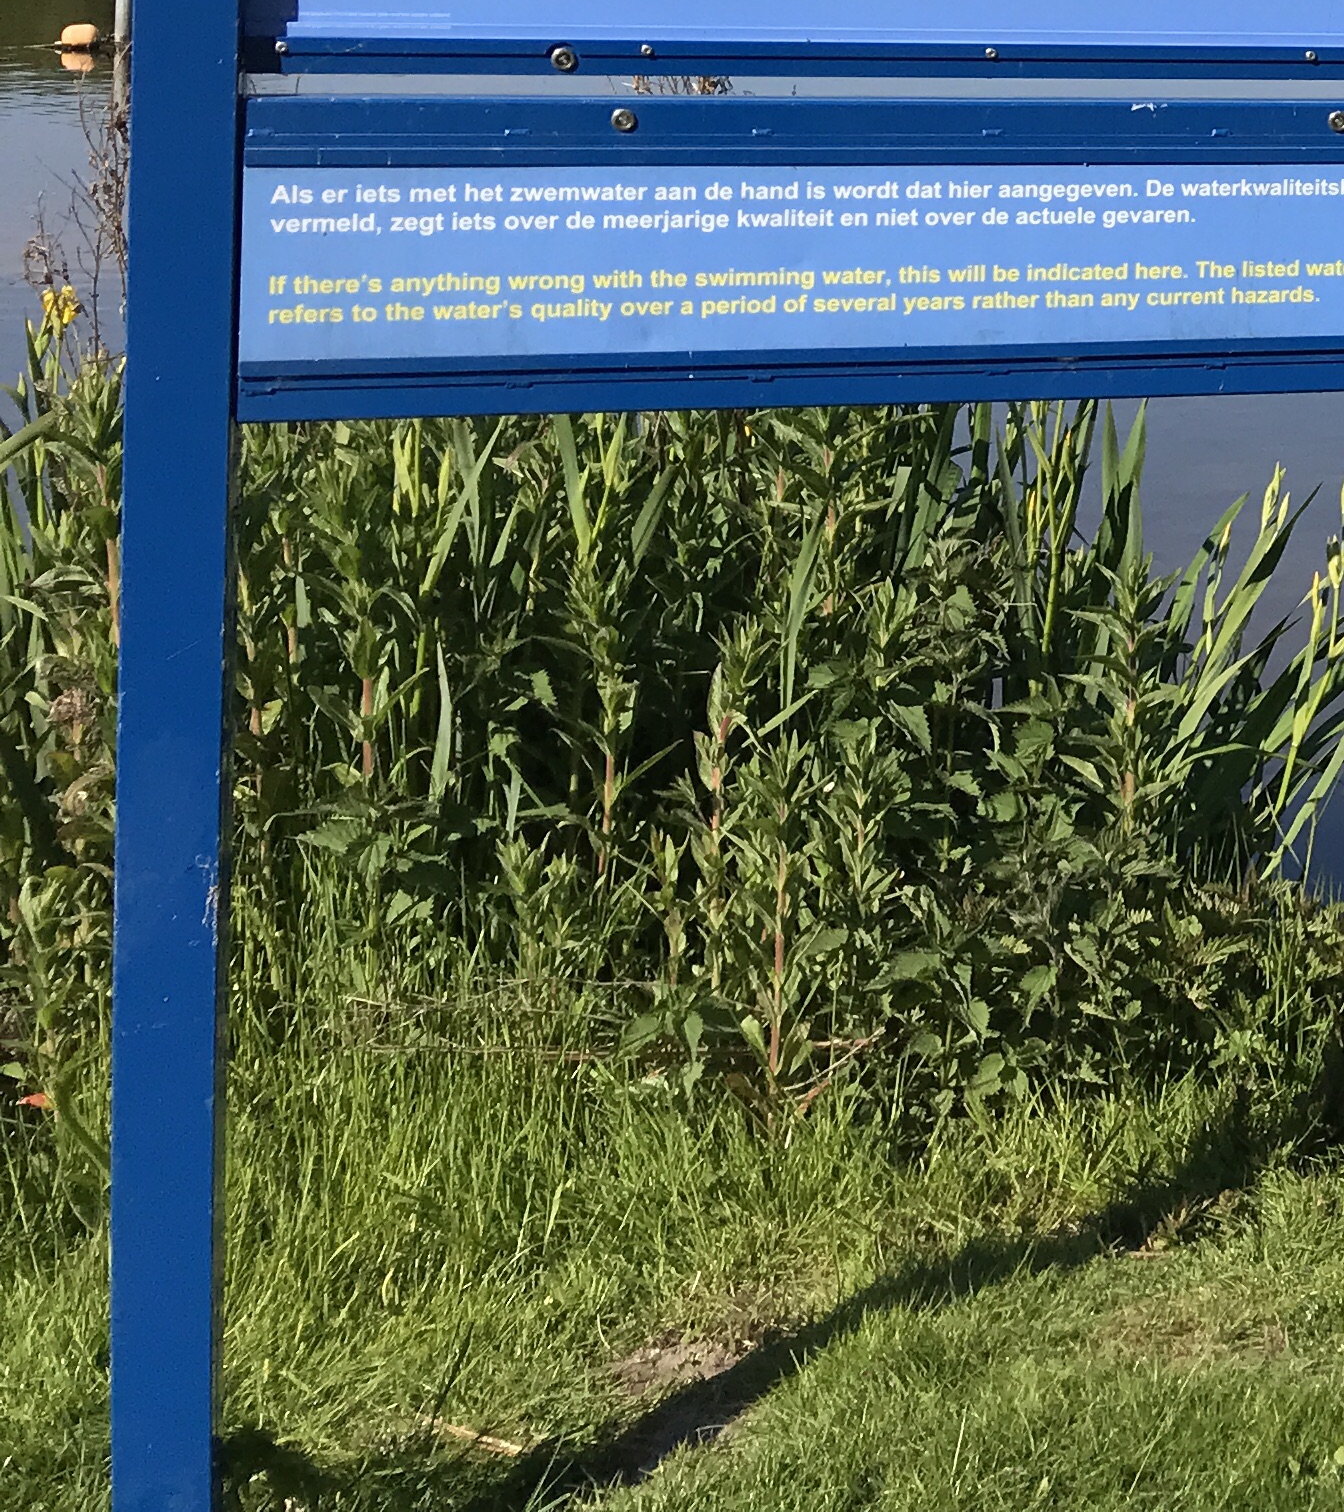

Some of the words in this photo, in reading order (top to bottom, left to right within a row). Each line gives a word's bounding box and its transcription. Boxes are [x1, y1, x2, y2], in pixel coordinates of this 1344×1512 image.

[270, 184, 313, 204] Als
[321, 188, 348, 203] er
[356, 184, 401, 203] iets
[409, 184, 456, 202] met
[464, 183, 503, 202] het
[509, 183, 648, 202] zwemwater
[654, 186, 696, 200] aan
[704, 181, 733, 200] de
[741, 181, 798, 200] hand
[806, 181, 825, 199] is
[833, 181, 899, 199] wordt
[905, 180, 942, 199] dat
[948, 180, 992, 198] hier
[998, 183, 1138, 201] aangegeven.
[1146, 179, 1174, 196] De
[270, 212, 381, 235] vermeld,
[390, 212, 444, 235] zegt
[451, 211, 496, 230] iets
[504, 215, 559, 230] over
[565, 210, 595, 229] de
[603, 209, 729, 233] meerjarige
[737, 209, 833, 227] kwaliteit
[840, 212, 868, 226] en
[876, 208, 918, 226] niet
[924, 211, 976, 226] over
[981, 208, 1008, 225] de
[1015, 207, 1096, 224] actuele
[1102, 209, 1195, 228] gevaren.
[269, 275, 287, 294] If
[293, 274, 382, 294] there's
[390, 272, 500, 294] anything
[507, 274, 584, 292] wrong
[592, 269, 642, 288] with
[650, 269, 687, 288] the
[695, 267, 815, 289] swimming
[822, 267, 891, 286] water,
[898, 265, 940, 283] this
[947, 264, 985, 282] will
[992, 264, 1020, 282] be
[1026, 262, 1128, 281] indicated
[1135, 262, 1188, 279] here.
[1195, 260, 1235, 278] The
[1242, 259, 1299, 277] listed
[268, 303, 343, 324] refers
[351, 304, 377, 322] to
[384, 302, 425, 321] the
[432, 299, 522, 320] water's
[530, 298, 612, 320] quality
[620, 300, 674, 316] over
[680, 300, 693, 315] a
[701, 294, 776, 318] period
[783, 294, 808, 313] of
[813, 292, 896, 312] several
[903, 295, 965, 315] years
[972, 290, 1040, 309] rather
[1045, 290, 1093, 308] than
[1100, 292, 1140, 310] any
[1146, 287, 1224, 306] current
[1231, 285, 1319, 304] hazards.
